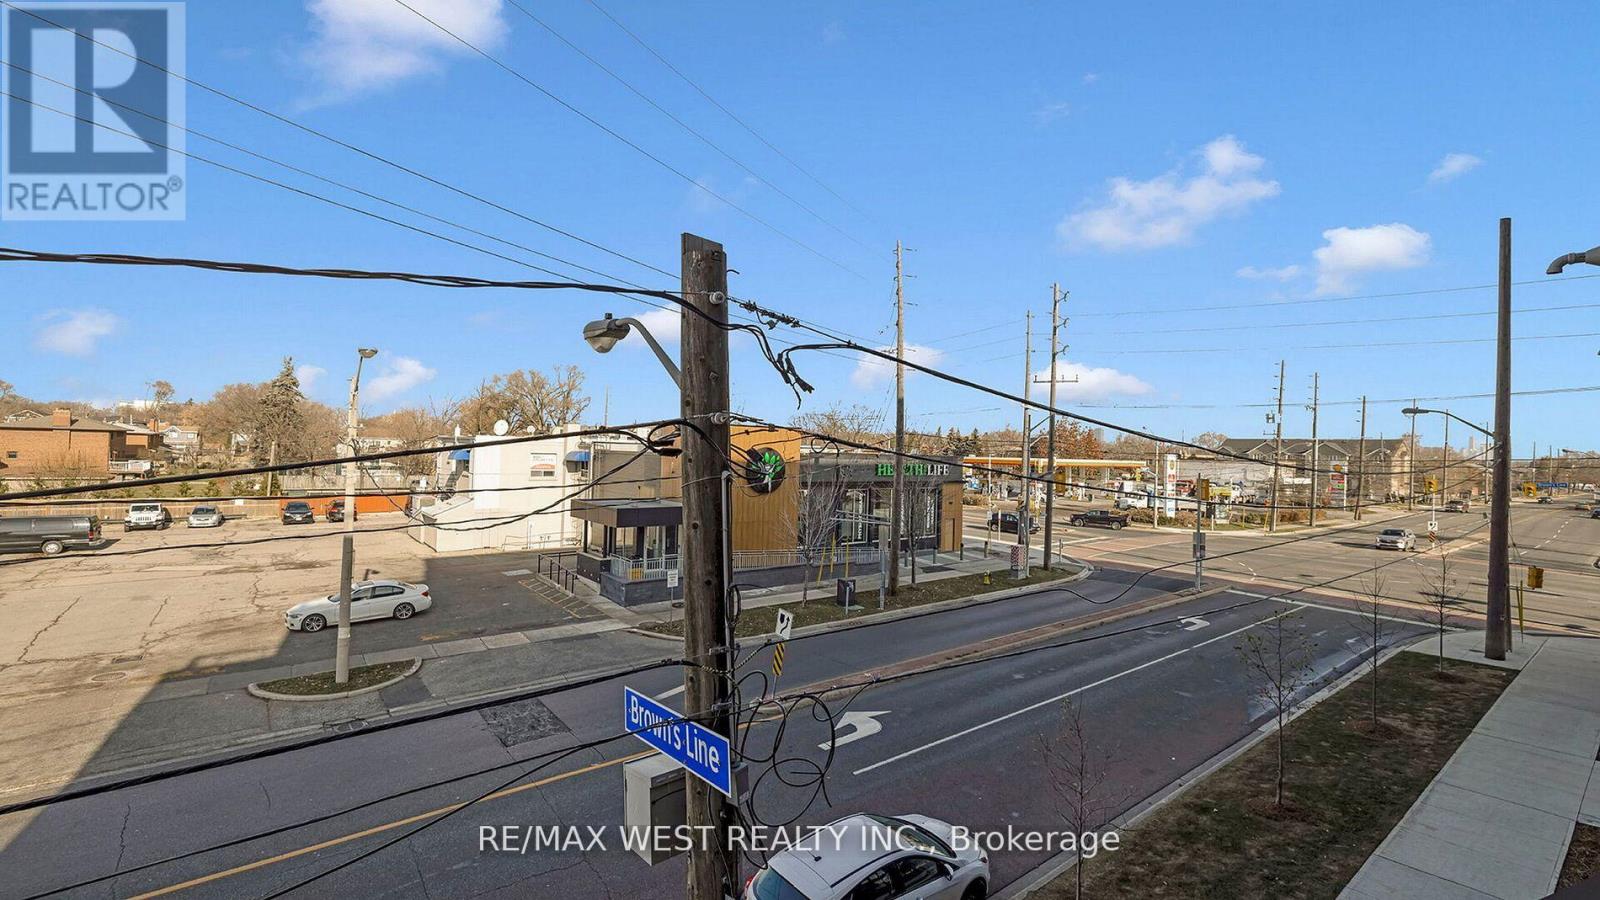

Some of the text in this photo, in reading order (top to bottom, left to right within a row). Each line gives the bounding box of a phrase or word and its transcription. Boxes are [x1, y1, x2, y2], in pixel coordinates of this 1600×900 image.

[927, 463, 950, 476] LIFE
[631, 695, 720, 773] Brown's Line
